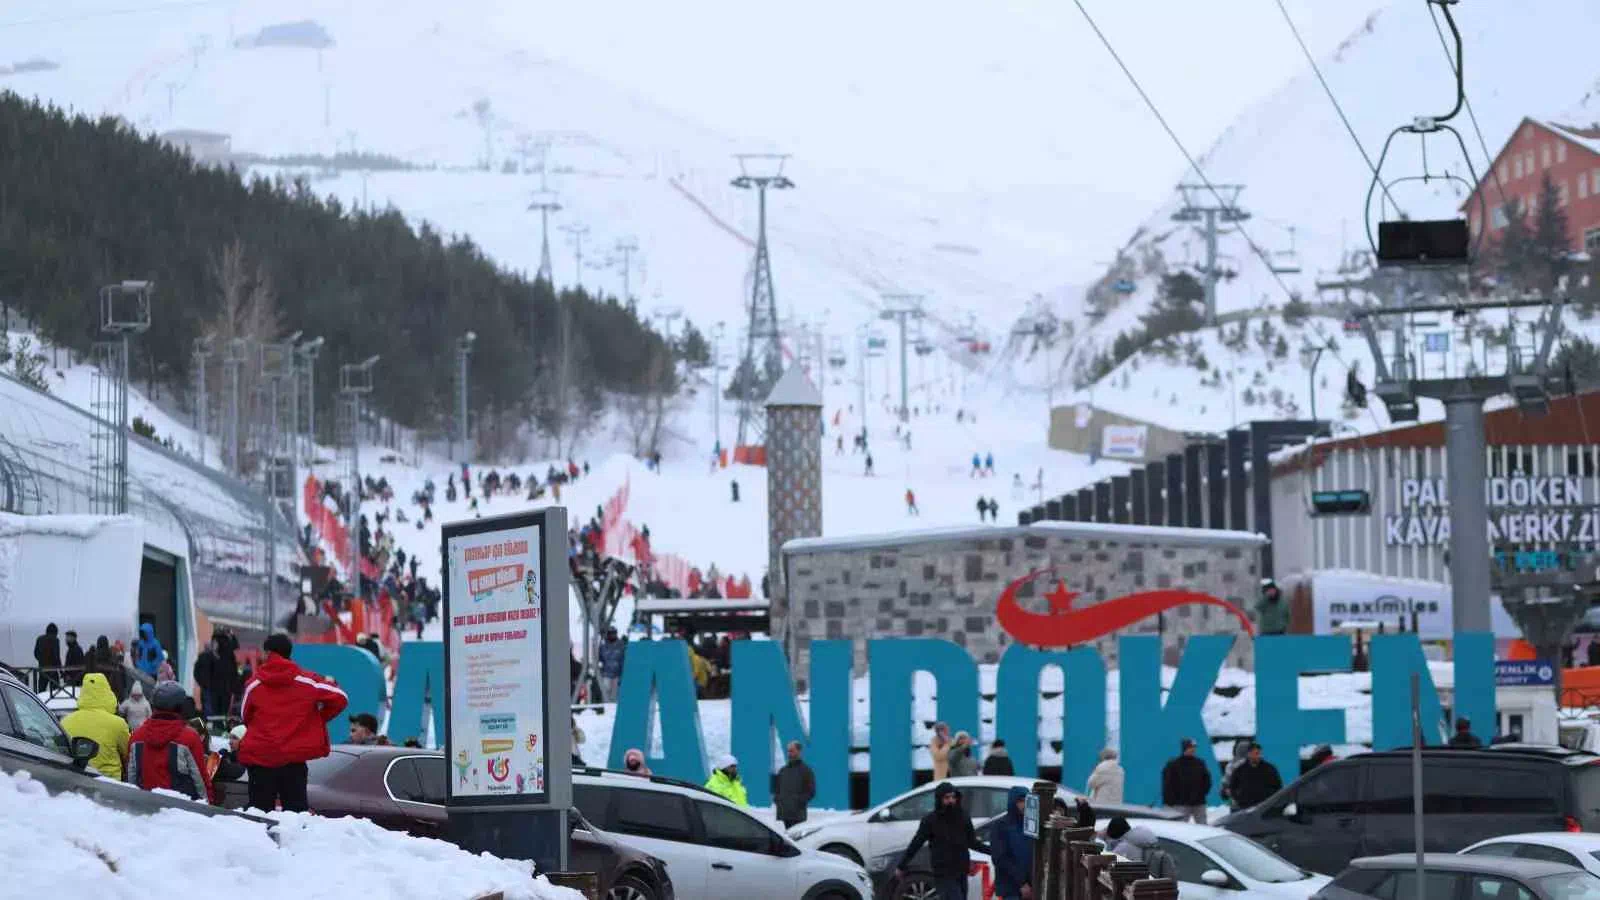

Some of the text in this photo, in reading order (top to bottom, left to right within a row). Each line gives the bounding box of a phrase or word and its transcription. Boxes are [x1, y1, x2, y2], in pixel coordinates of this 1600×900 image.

[1402, 470, 1583, 506] PALDÖKEN
[1385, 515, 1453, 545] KAYA
[1329, 596, 1438, 614] maximiles
